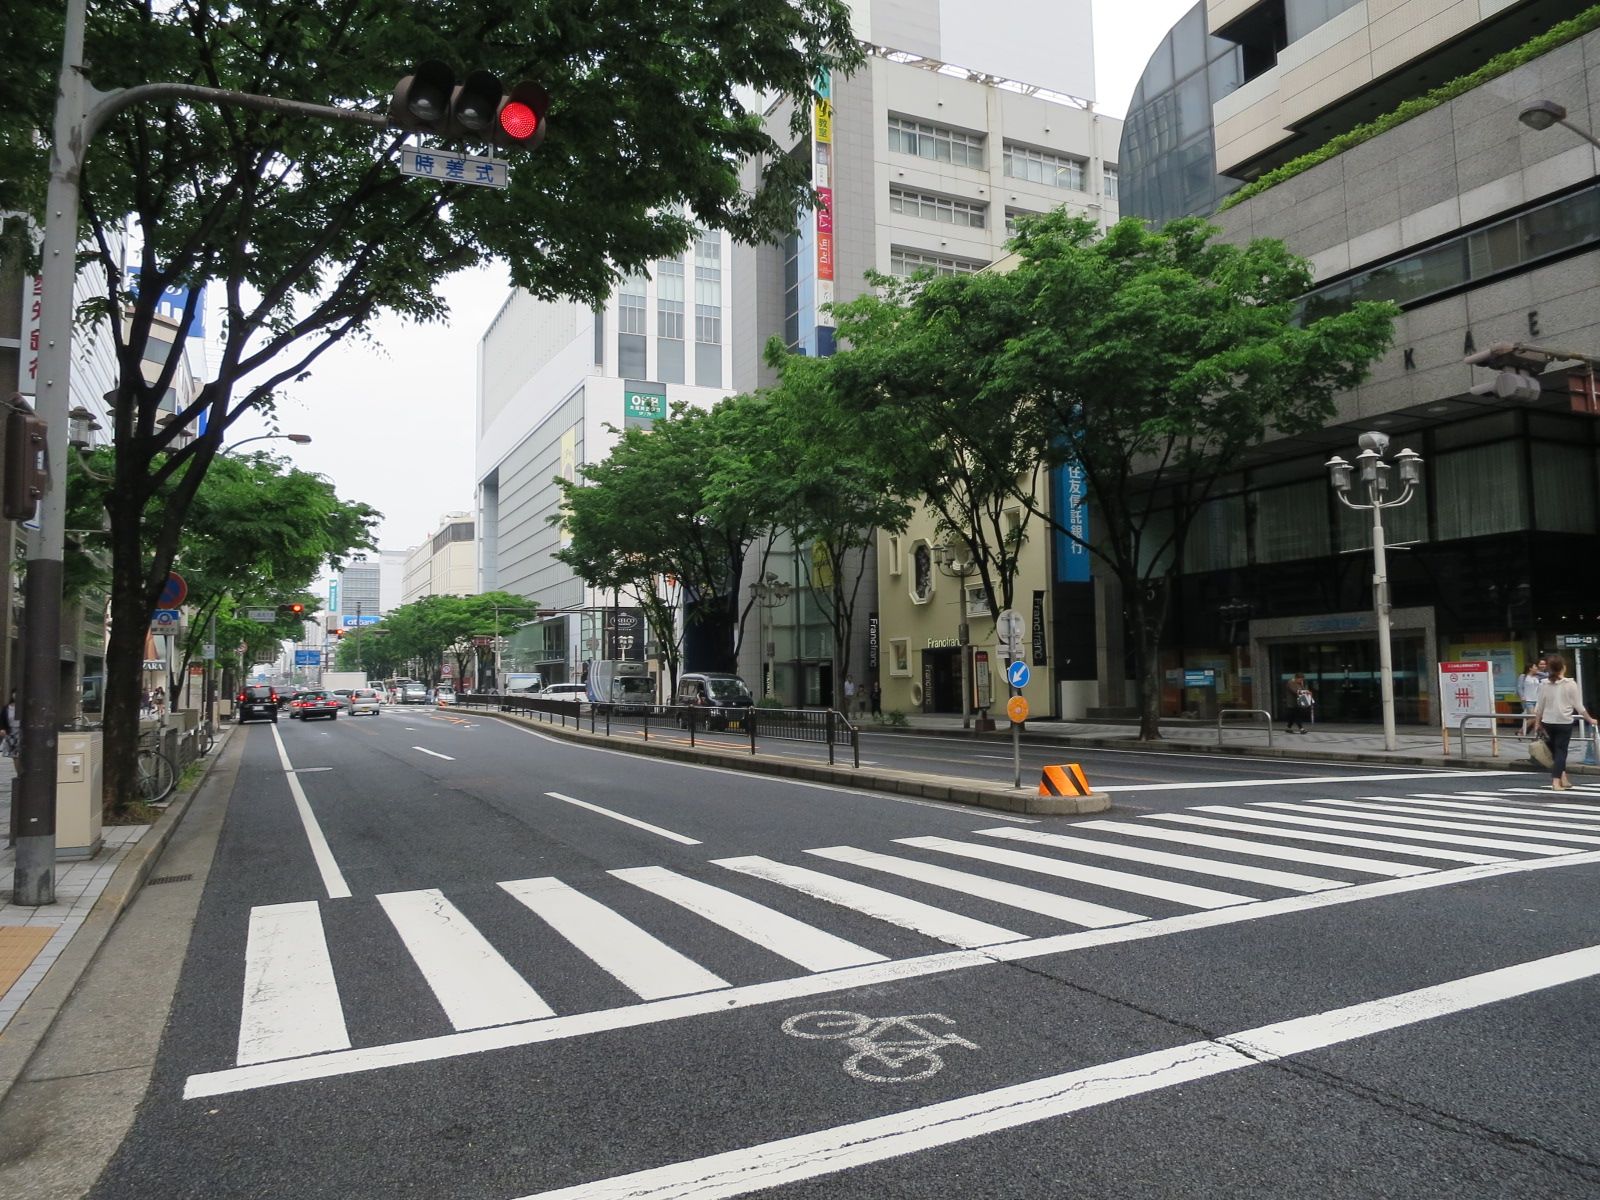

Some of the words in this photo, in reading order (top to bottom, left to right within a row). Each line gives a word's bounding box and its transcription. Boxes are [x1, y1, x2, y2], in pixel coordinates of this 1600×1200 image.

[415, 154, 494, 183] 時差式
[869, 618, 879, 668] Francfranc
[927, 636, 962, 648] Francfran
[1033, 598, 1045, 660] Francfranc
[924, 664, 934, 705] Francfranc
